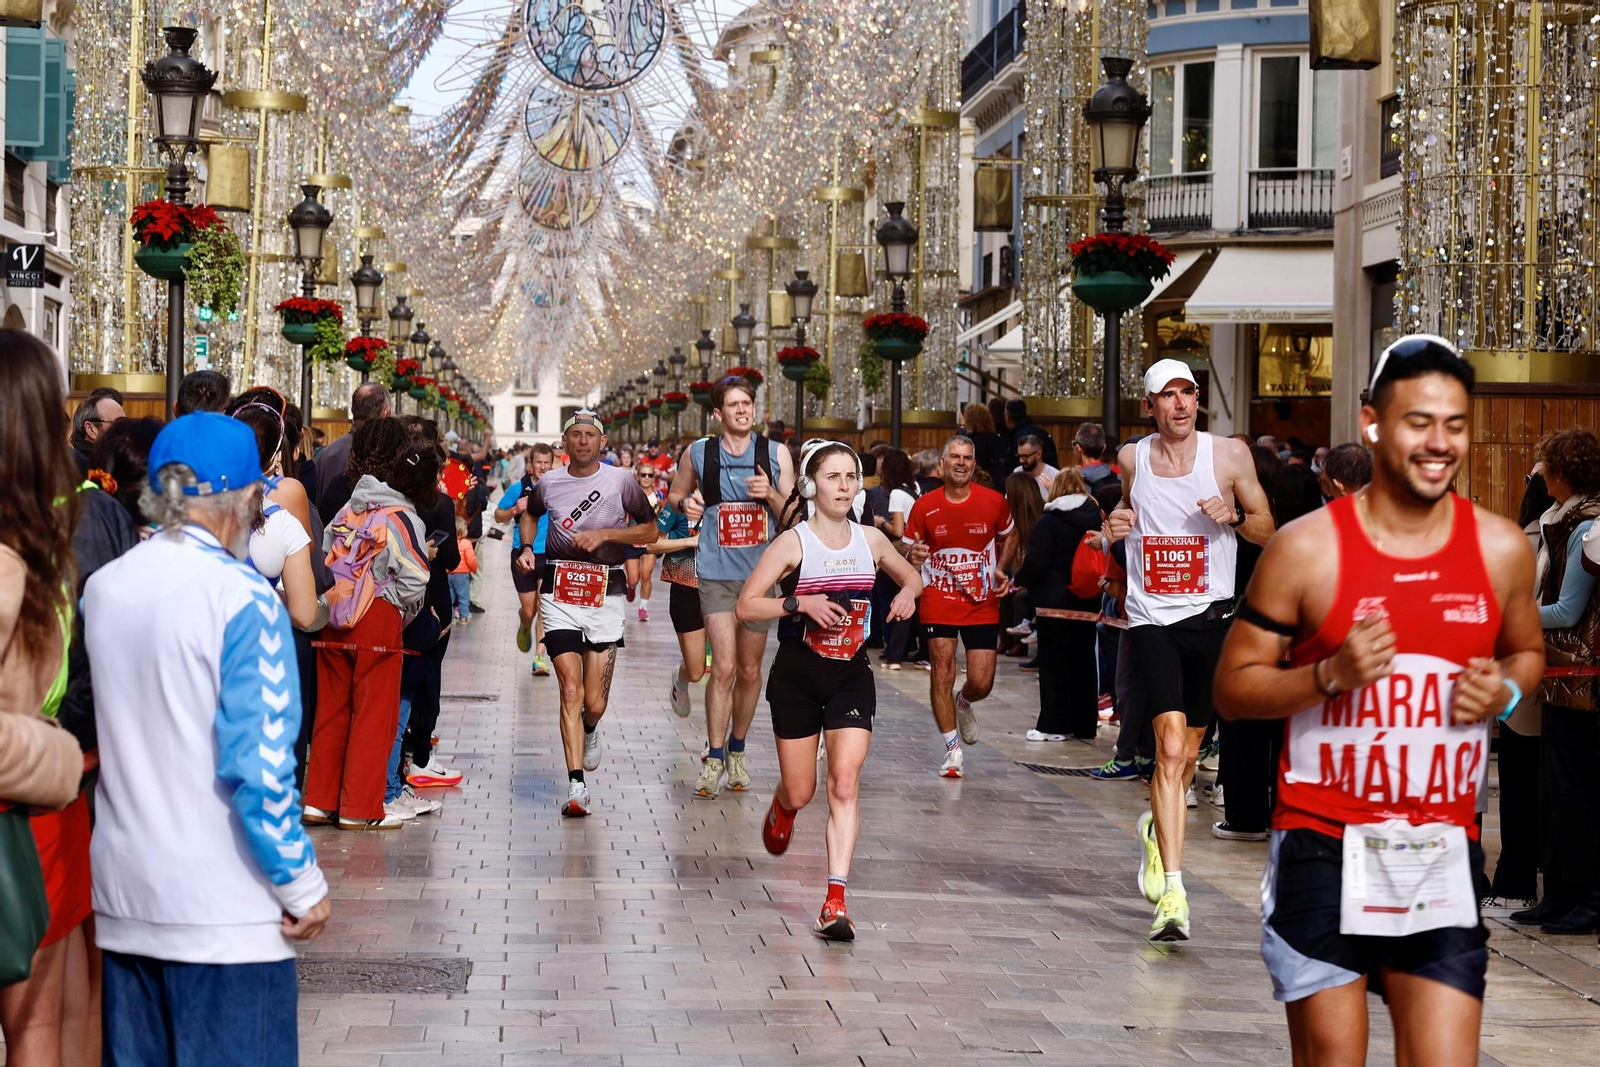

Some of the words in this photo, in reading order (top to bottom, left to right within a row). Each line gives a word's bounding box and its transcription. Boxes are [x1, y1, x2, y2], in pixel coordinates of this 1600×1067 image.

[12, 245, 39, 270] V
[1233, 309, 1249, 320] La
[1250, 309, 1291, 320] Canasta
[1270, 383, 1298, 391] TAKE
[728, 514, 753, 523] 6310
[1158, 537, 1200, 545] GENERALI
[1154, 550, 1192, 562] 11061
[566, 571, 591, 582] 6261
